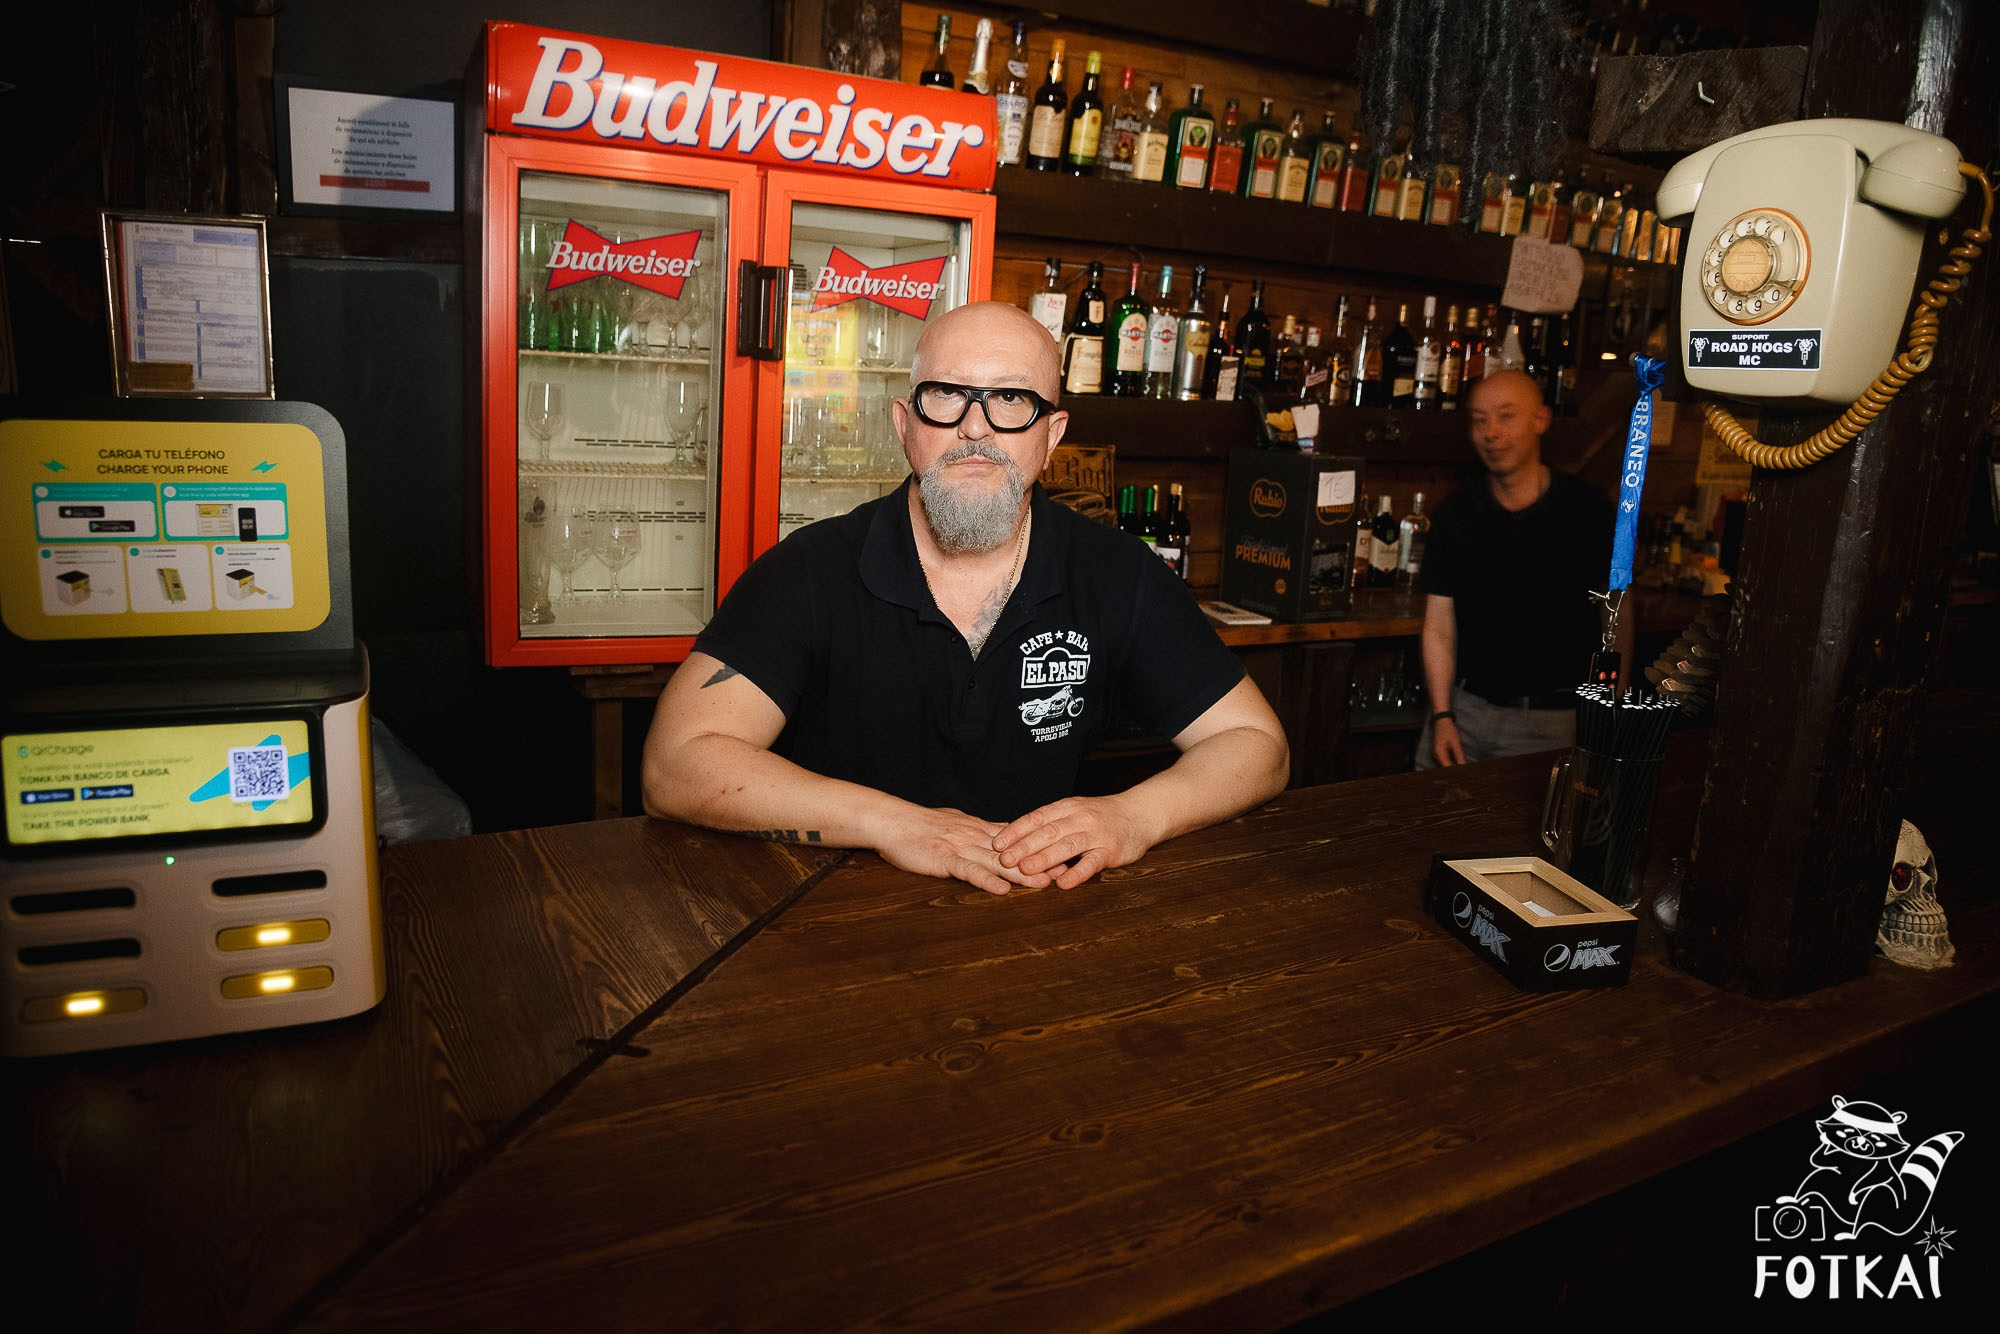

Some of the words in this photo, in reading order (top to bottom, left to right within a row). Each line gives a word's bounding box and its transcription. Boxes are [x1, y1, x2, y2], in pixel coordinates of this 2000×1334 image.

[511, 36, 986, 179] Budweiser
[546, 241, 701, 279] Budweiser
[813, 266, 947, 301] Budweiser
[1735, 299, 1743, 312] 8
[1754, 299, 1763, 312] 9
[1711, 342, 1749, 353] ROAD
[1751, 342, 1794, 353] HOGS
[1738, 355, 1761, 366] MC
[98, 449, 143, 460] CARGA
[145, 449, 161, 460] TU
[164, 447, 225, 460] TELÉFONO
[1625, 396, 1649, 488] RRANEO
[97, 464, 149, 475] CHARGE
[152, 464, 185, 475] YOUR
[187, 464, 229, 475] PHONE
[1253, 486, 1284, 509] Rubio
[1235, 543, 1292, 571] PREMIUM
[1019, 631, 1053, 655] CAFE
[1026, 662, 1046, 684] EL
[1048, 660, 1088, 682] PASO
[1031, 720, 1073, 736] TORREVIEJA
[1034, 732, 1057, 743] APOLO
[1477, 904, 1495, 920] pepsi
[1470, 913, 1512, 963] MAX
[1577, 938, 1599, 949] pepsi
[1569, 944, 1622, 970] MAX
